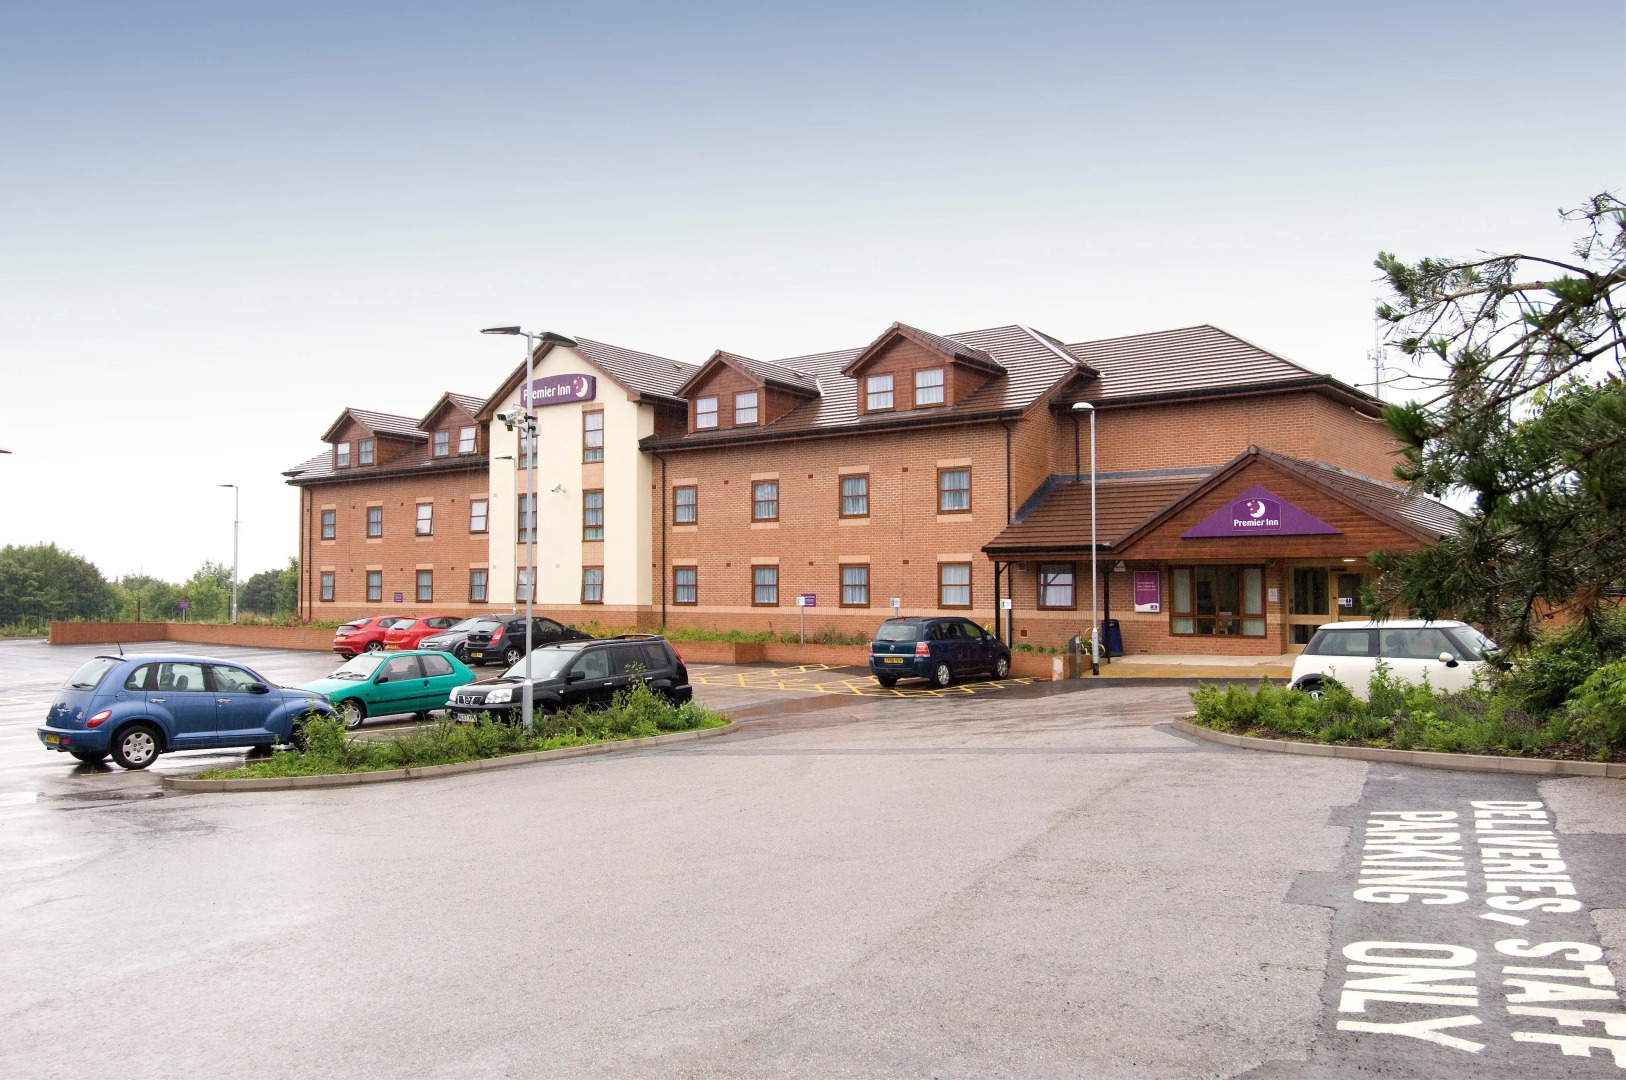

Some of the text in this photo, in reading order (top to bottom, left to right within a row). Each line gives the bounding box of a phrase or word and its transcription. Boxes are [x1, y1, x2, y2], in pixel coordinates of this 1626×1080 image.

[523, 384, 571, 401] Pemier Inn
[1233, 518, 1279, 527] Premier Inn
[1336, 810, 1486, 1054] PARKING ONLY
[1470, 800, 1626, 1069] DELIVERIES, STAFF
